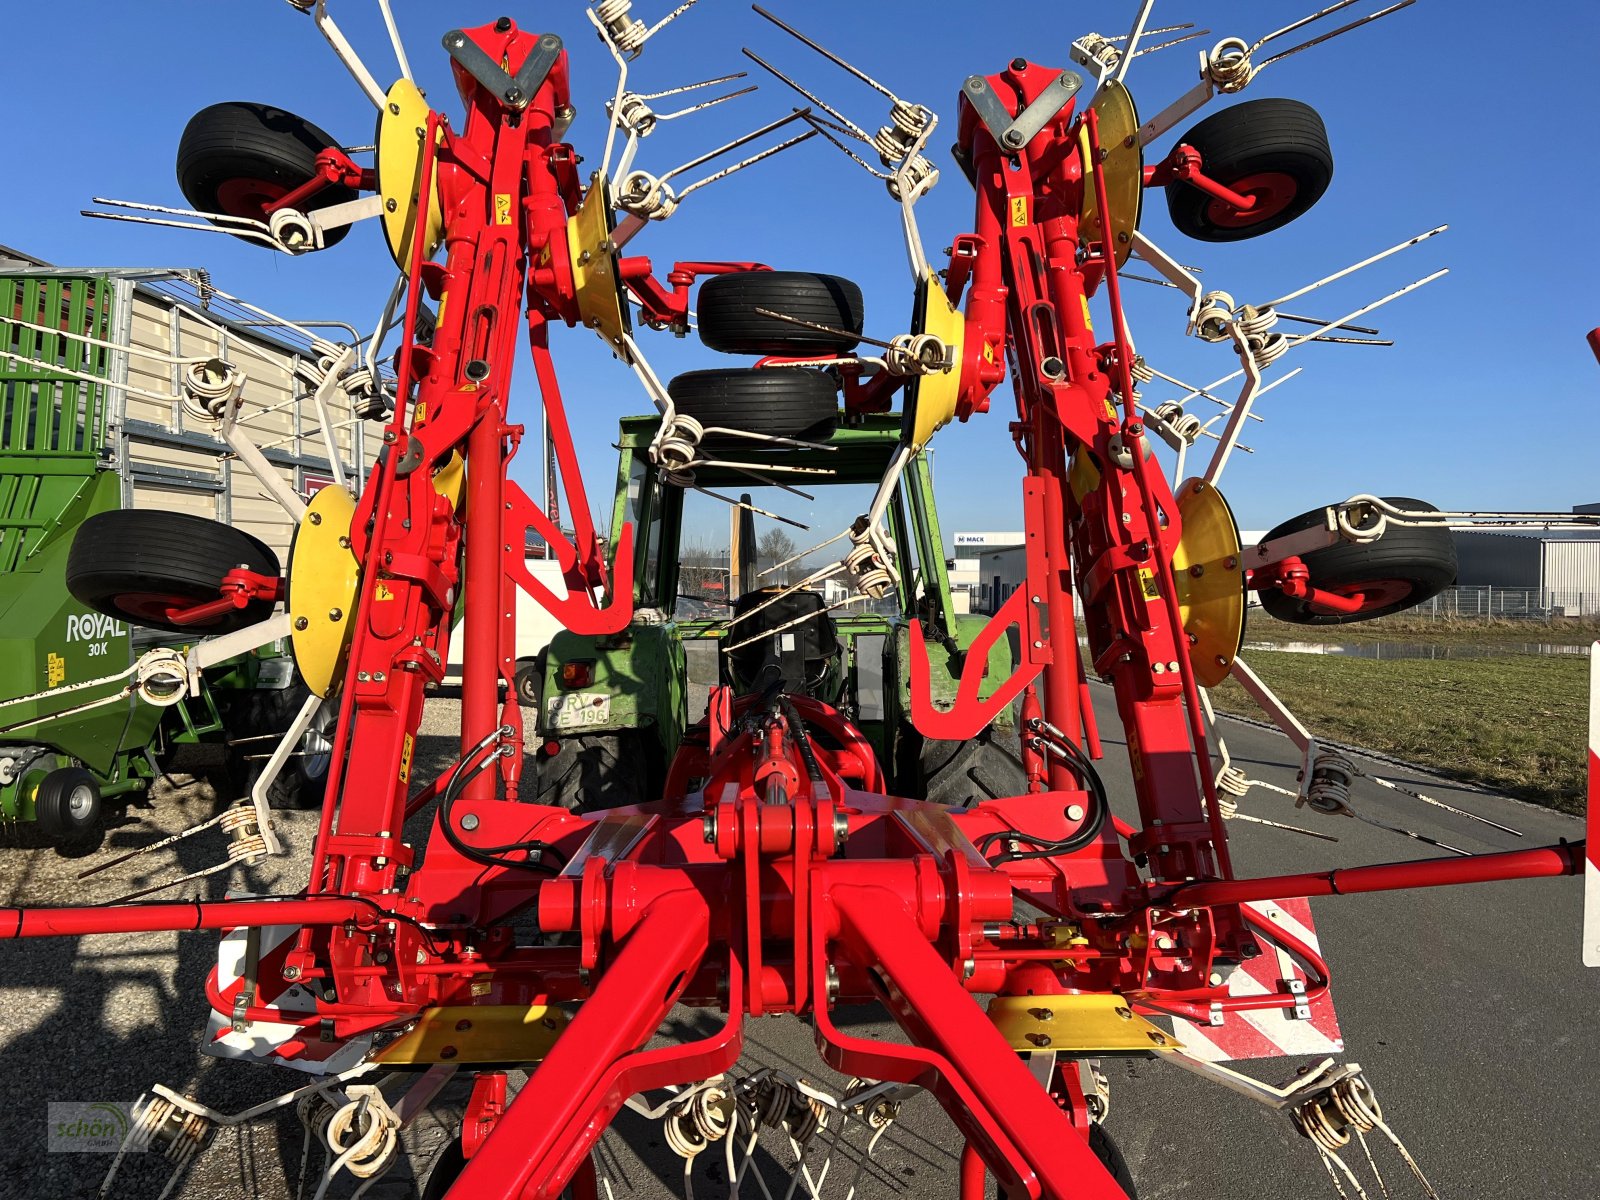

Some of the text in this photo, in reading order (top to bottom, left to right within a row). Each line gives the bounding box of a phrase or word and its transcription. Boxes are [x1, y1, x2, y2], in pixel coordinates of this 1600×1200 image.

[66, 613, 127, 642] ROYAL
[567, 695, 589, 711] RV
[560, 709, 605, 725] E 196
